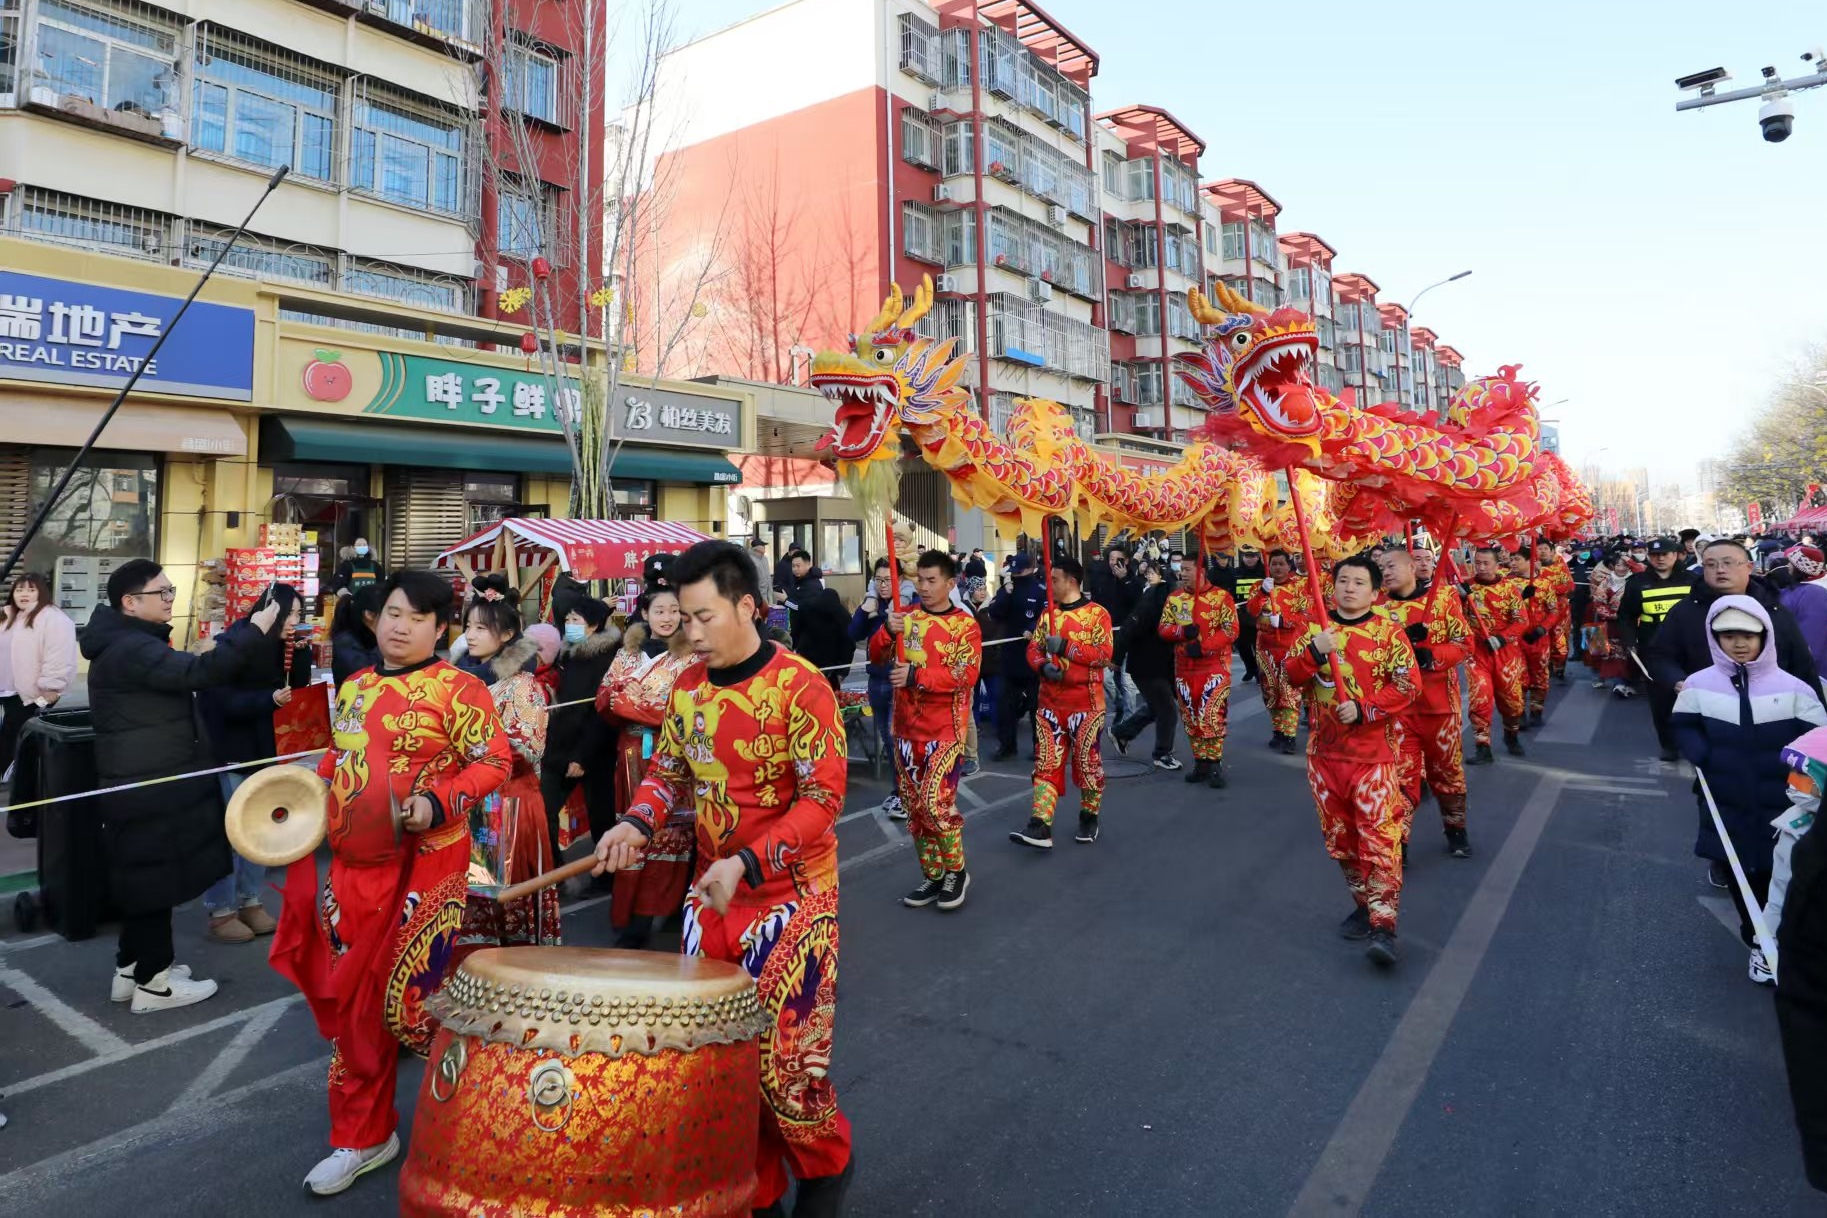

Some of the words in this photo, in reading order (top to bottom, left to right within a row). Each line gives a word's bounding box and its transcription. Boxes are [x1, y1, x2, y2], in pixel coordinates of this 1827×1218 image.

[0, 342, 65, 365] REAL
[71, 350, 158, 375] ESTATE
[659, 404, 732, 435] 柏丝美发
[388, 686, 427, 775] 中国北京
[754, 700, 781, 808] 中国北京
